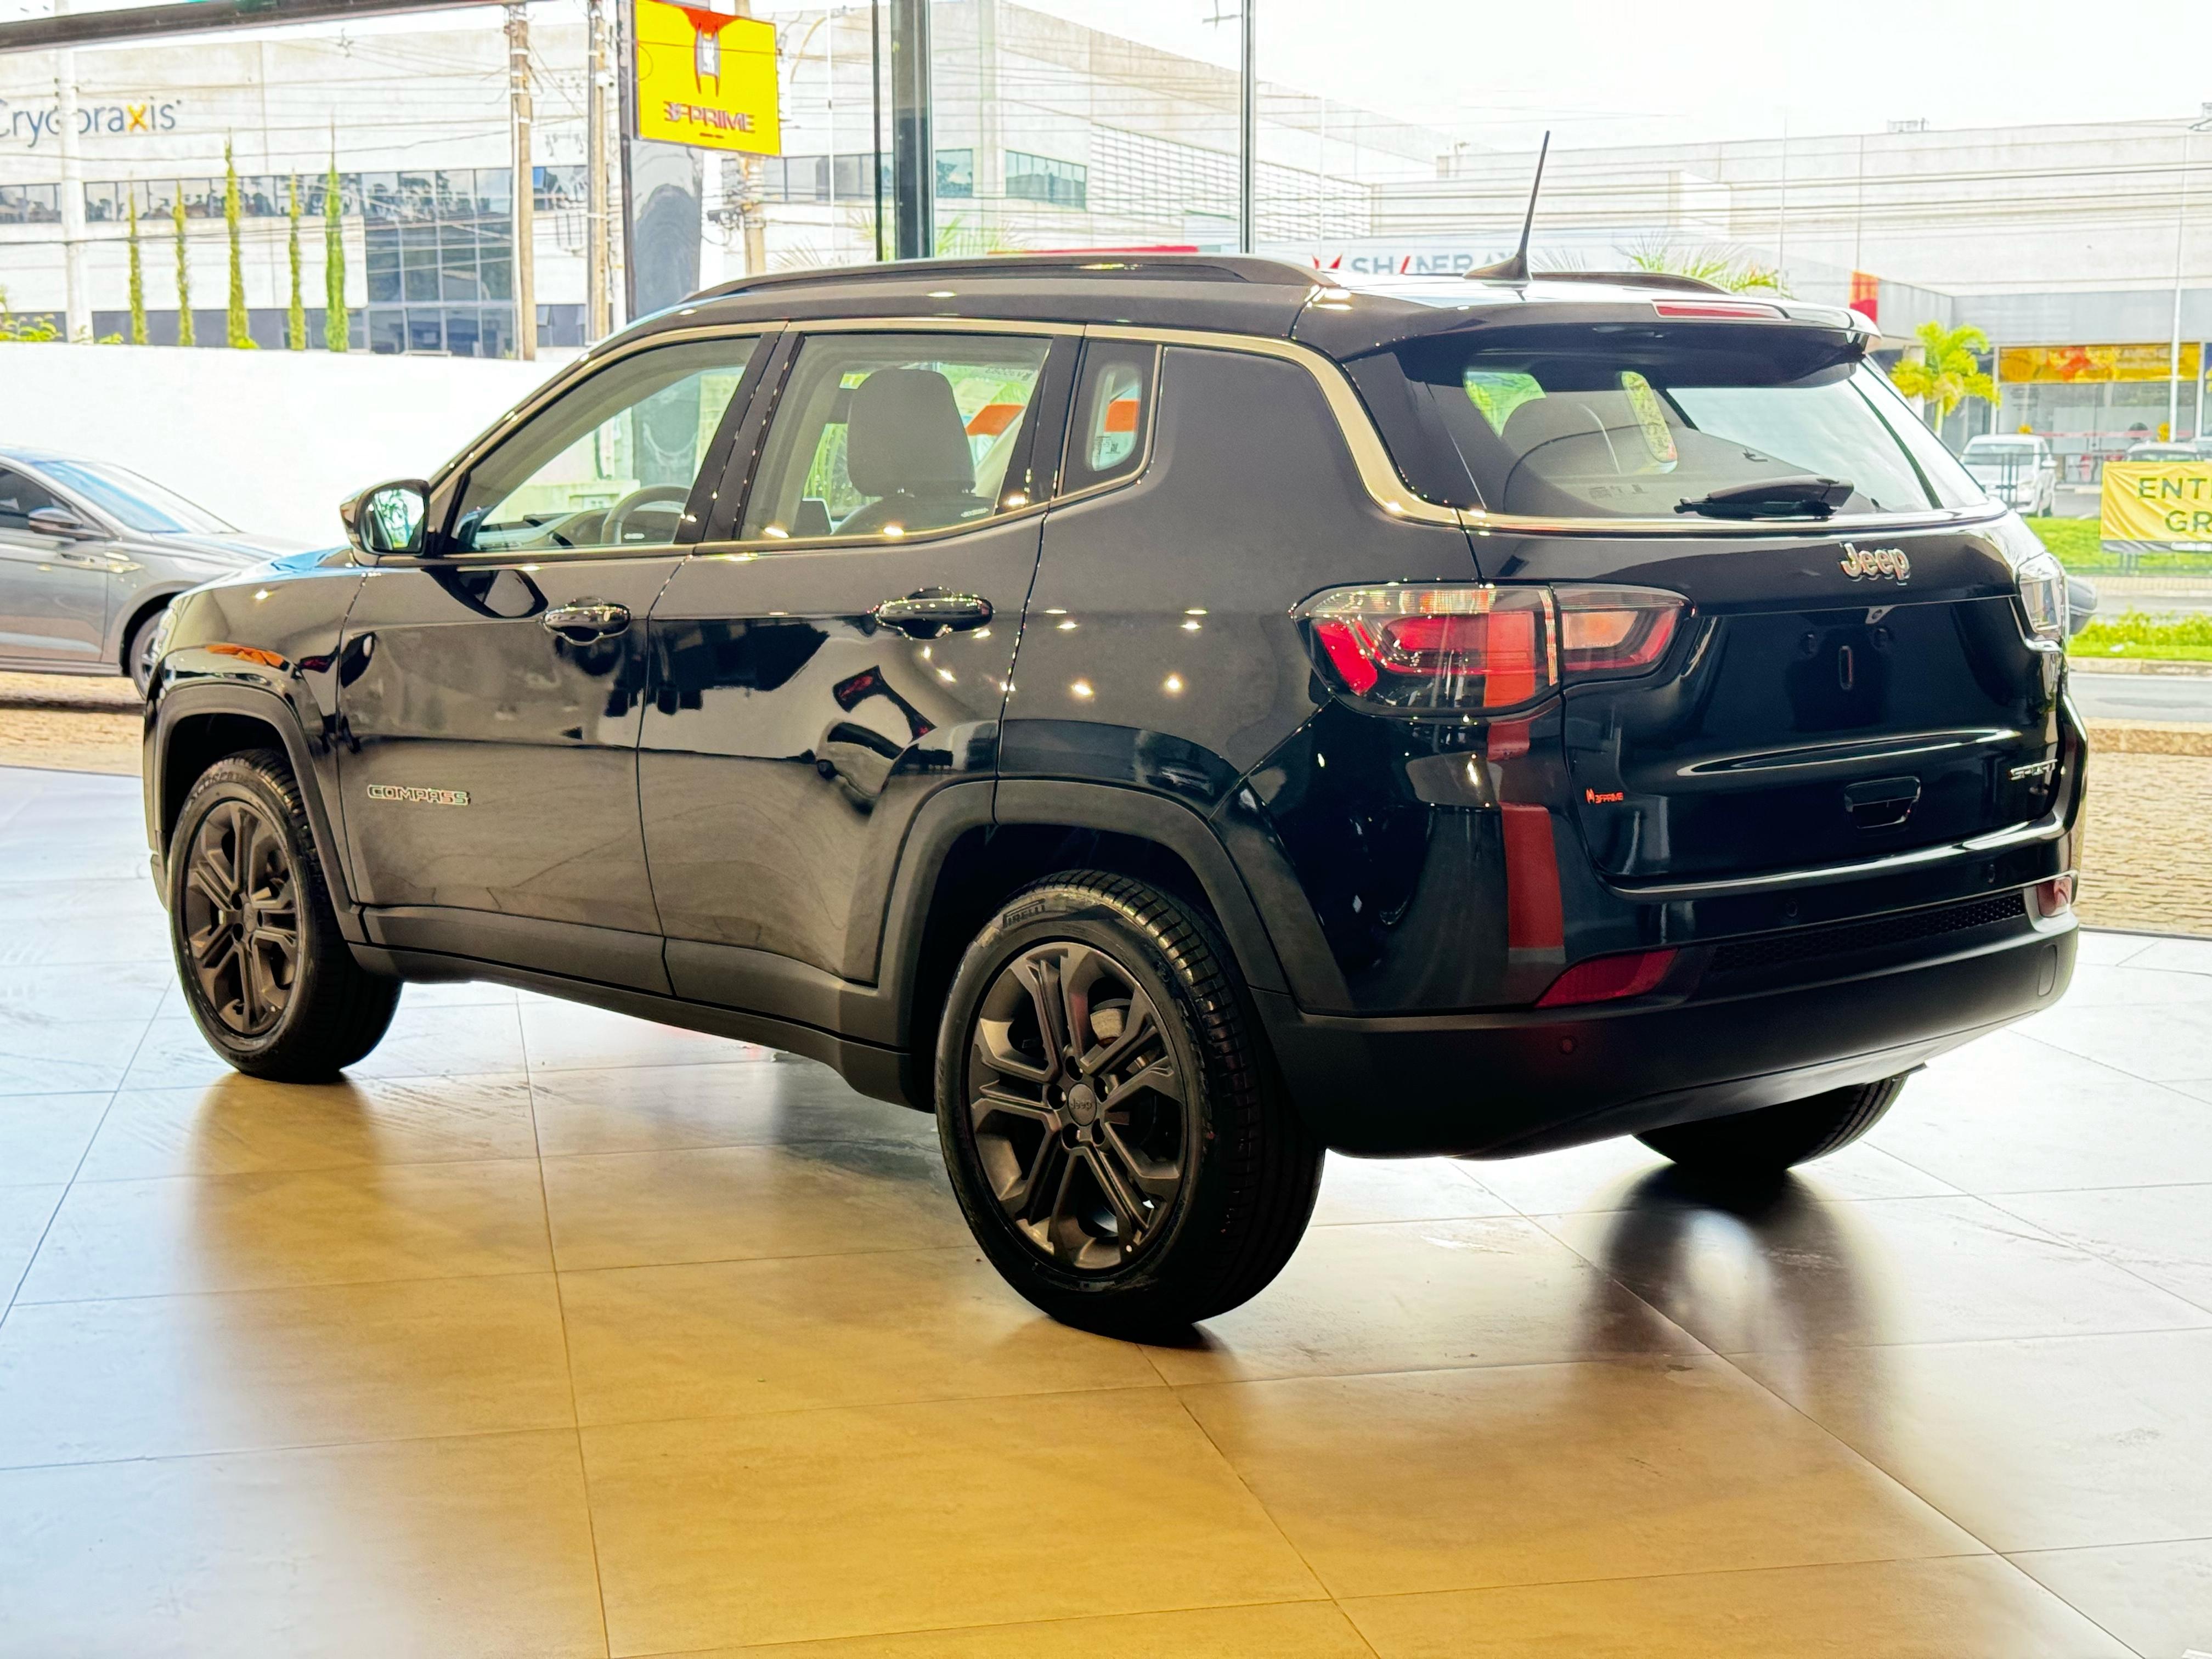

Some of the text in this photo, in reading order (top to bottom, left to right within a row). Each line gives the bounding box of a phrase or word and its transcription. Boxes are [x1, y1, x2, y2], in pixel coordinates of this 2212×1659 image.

[0, 96, 176, 148] ryoraxis
[2138, 477, 2212, 499] ENT
[2165, 510, 2212, 532] GR
[1841, 543, 1909, 580] Jeep
[367, 784, 470, 806] COMPASS
[1002, 898, 1045, 928] PIRELLI
